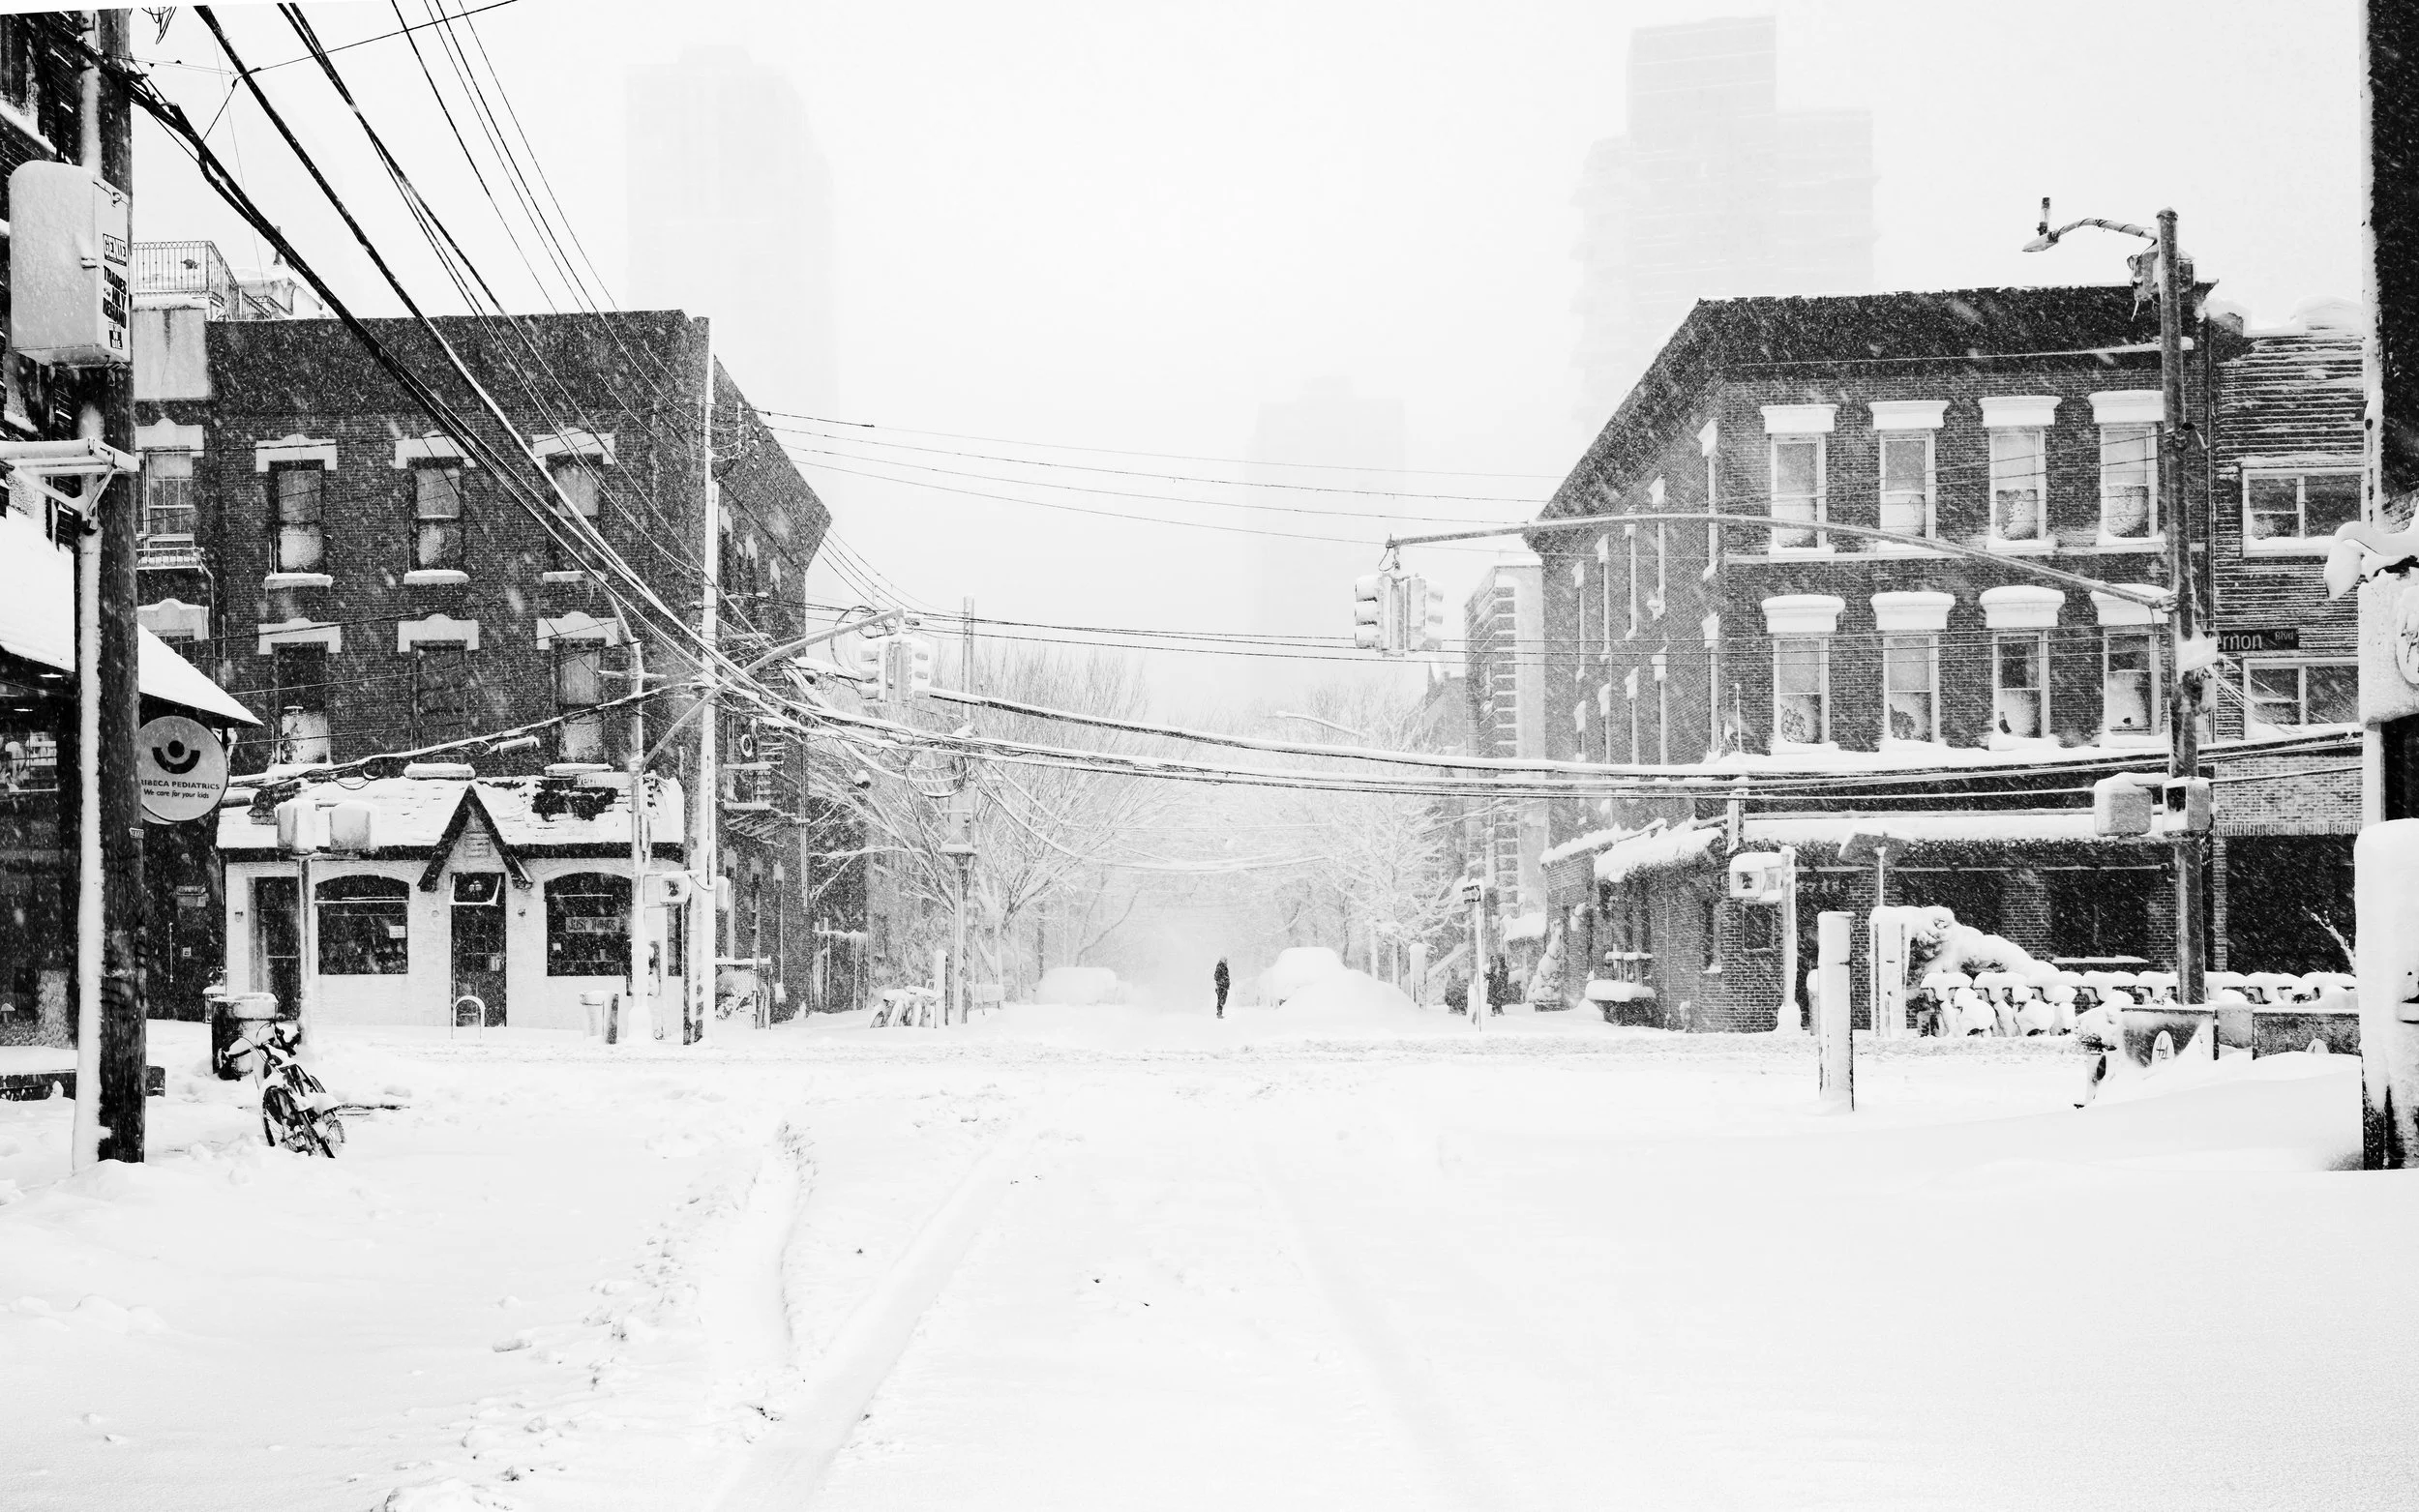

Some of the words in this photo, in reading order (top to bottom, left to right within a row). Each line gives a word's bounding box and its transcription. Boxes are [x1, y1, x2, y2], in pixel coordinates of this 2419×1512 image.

[2209, 634, 2263, 650] ernon
[2275, 631, 2294, 640] Blvd
[171, 781, 220, 790] PEDIATRICS
[171, 789, 180, 798] for
